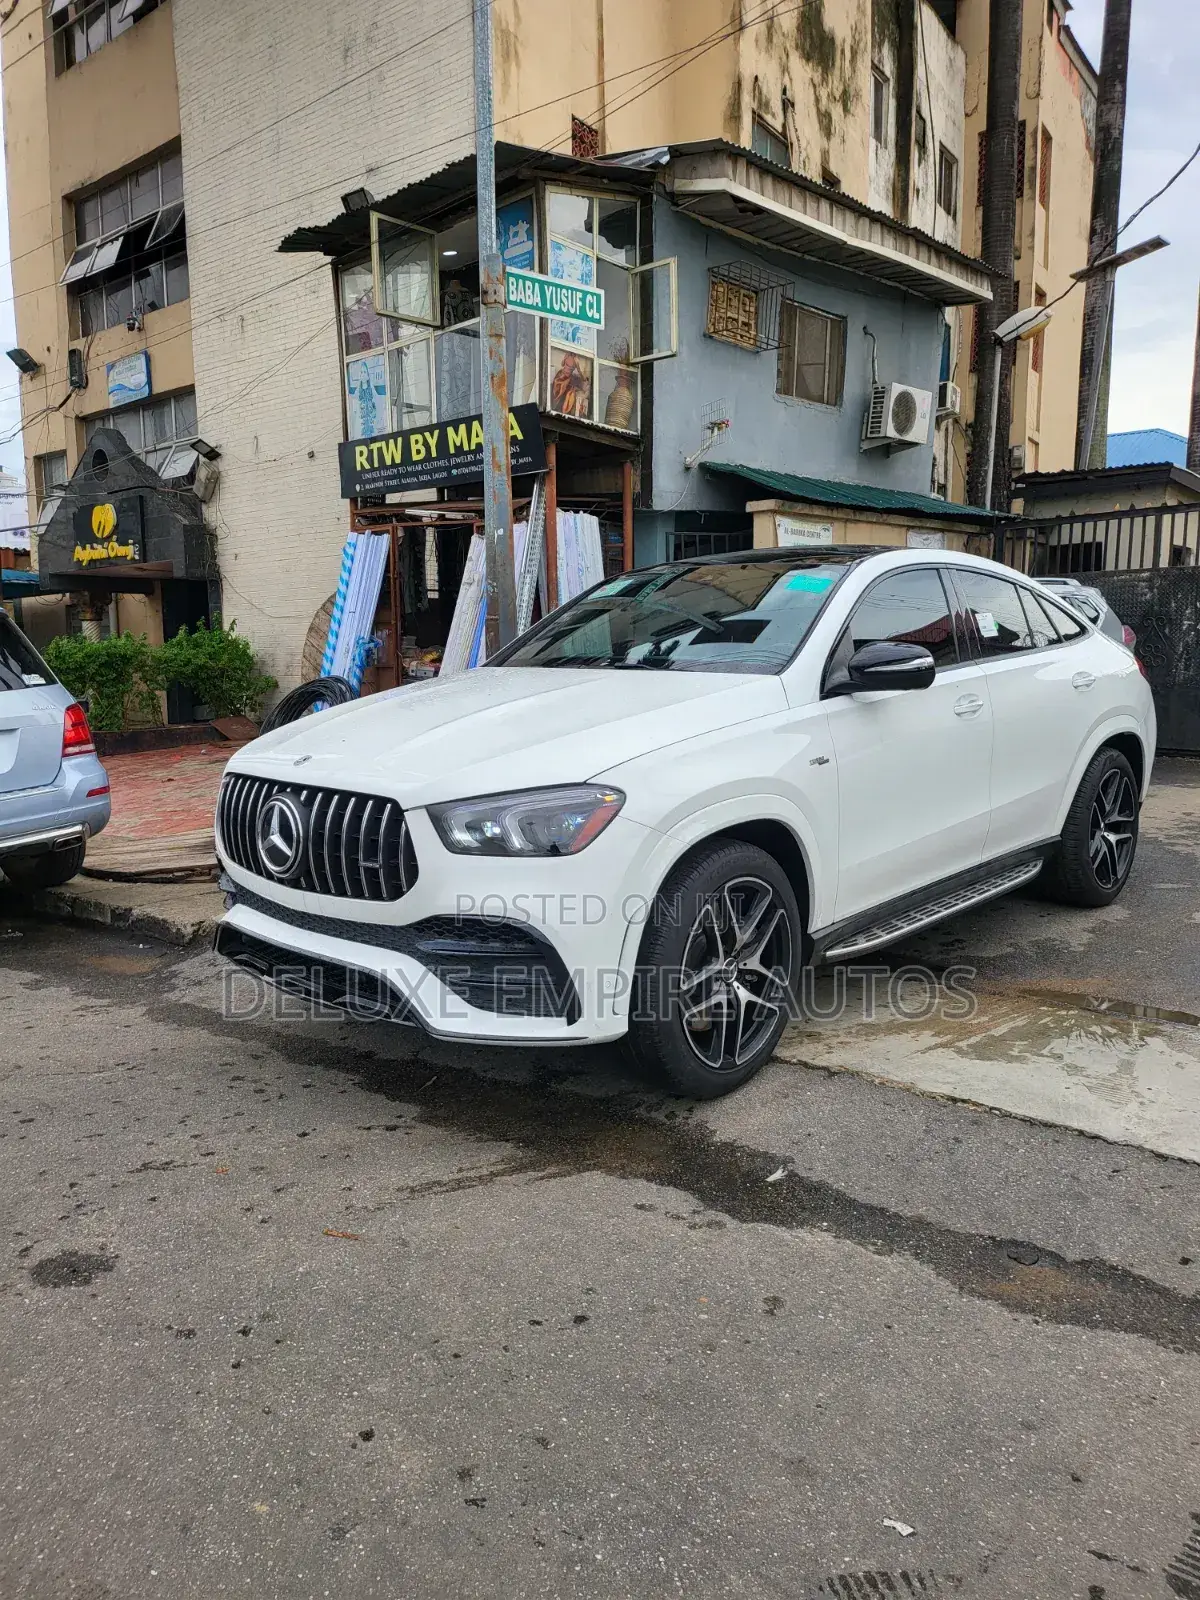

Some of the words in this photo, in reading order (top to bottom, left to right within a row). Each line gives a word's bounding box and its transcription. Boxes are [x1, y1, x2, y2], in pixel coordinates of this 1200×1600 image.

[508, 276, 542, 308] BABA
[544, 284, 583, 315] YUSUF
[586, 293, 600, 319] CL
[355, 436, 403, 471] RTW
[410, 429, 440, 461] BY
[446, 412, 524, 454] MAA
[380, 468, 398, 477] READY
[398, 466, 407, 474] TO
[406, 463, 422, 472] WEAR
[450, 454, 475, 466] JEWELRY
